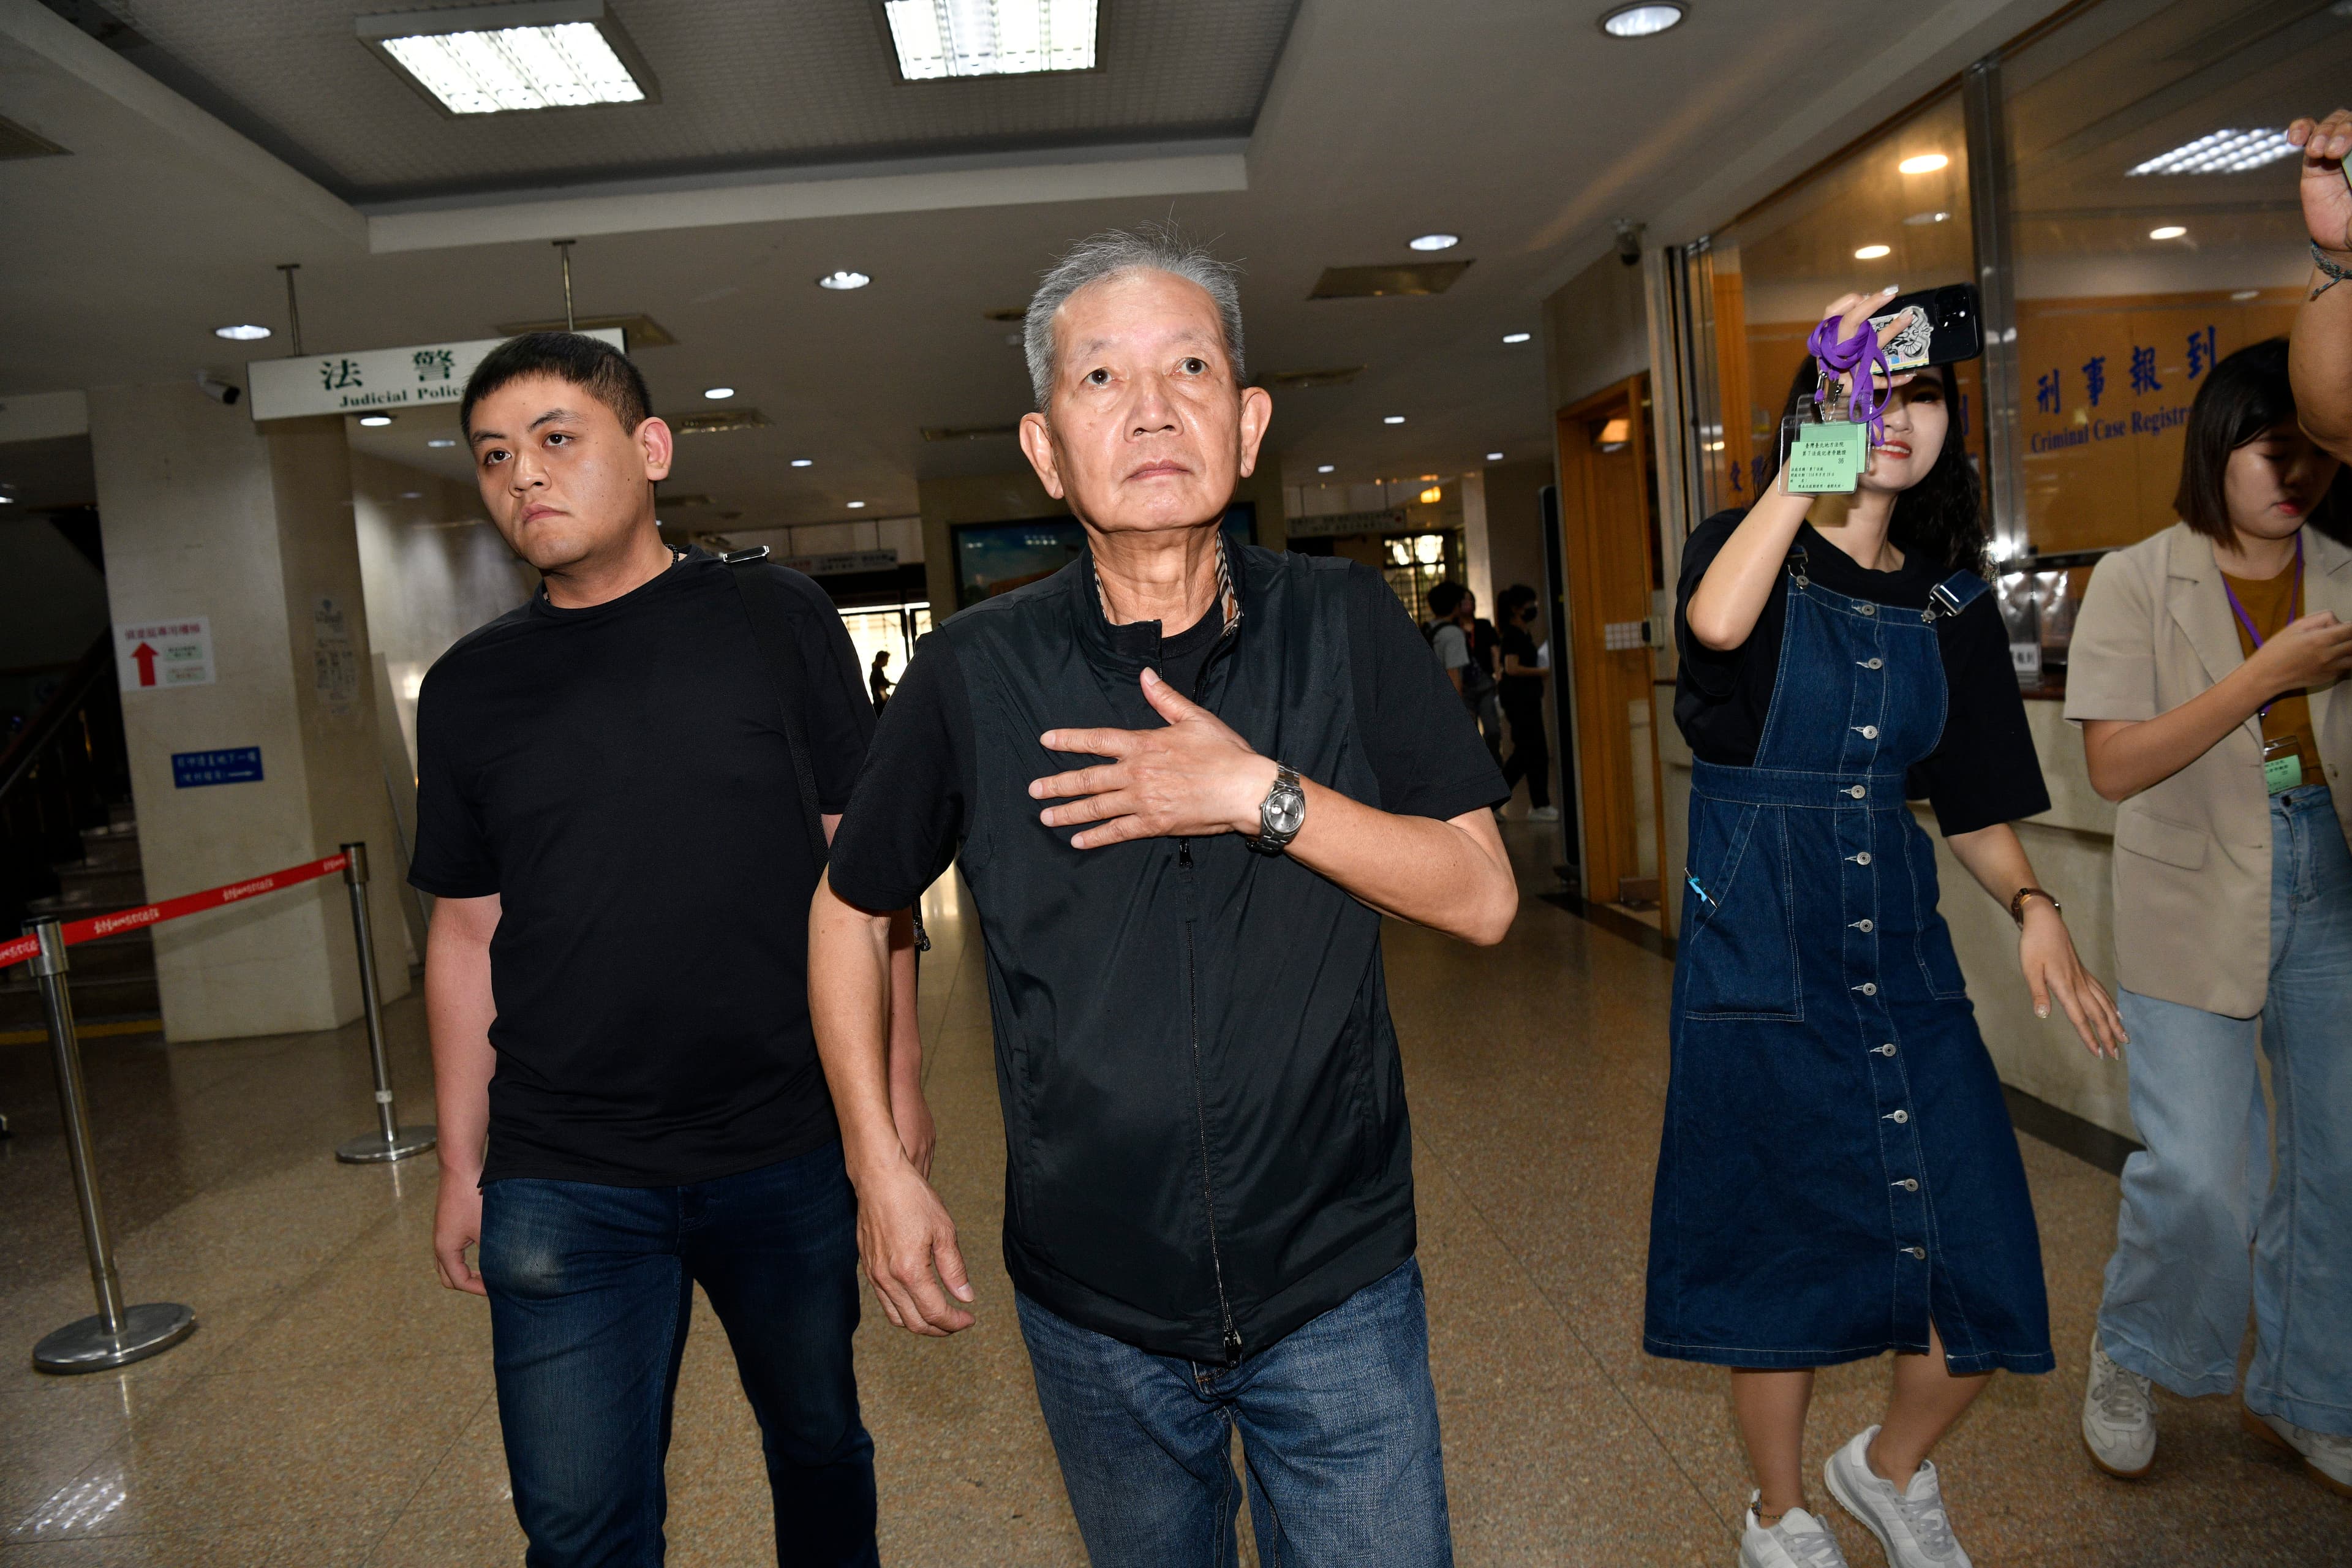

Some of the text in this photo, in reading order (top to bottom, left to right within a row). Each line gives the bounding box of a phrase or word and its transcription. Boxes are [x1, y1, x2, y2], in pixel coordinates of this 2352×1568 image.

[340, 390, 407, 407] Judicial
[2031, 423, 2089, 453] Criminal
[2093, 419, 2125, 441] Case
